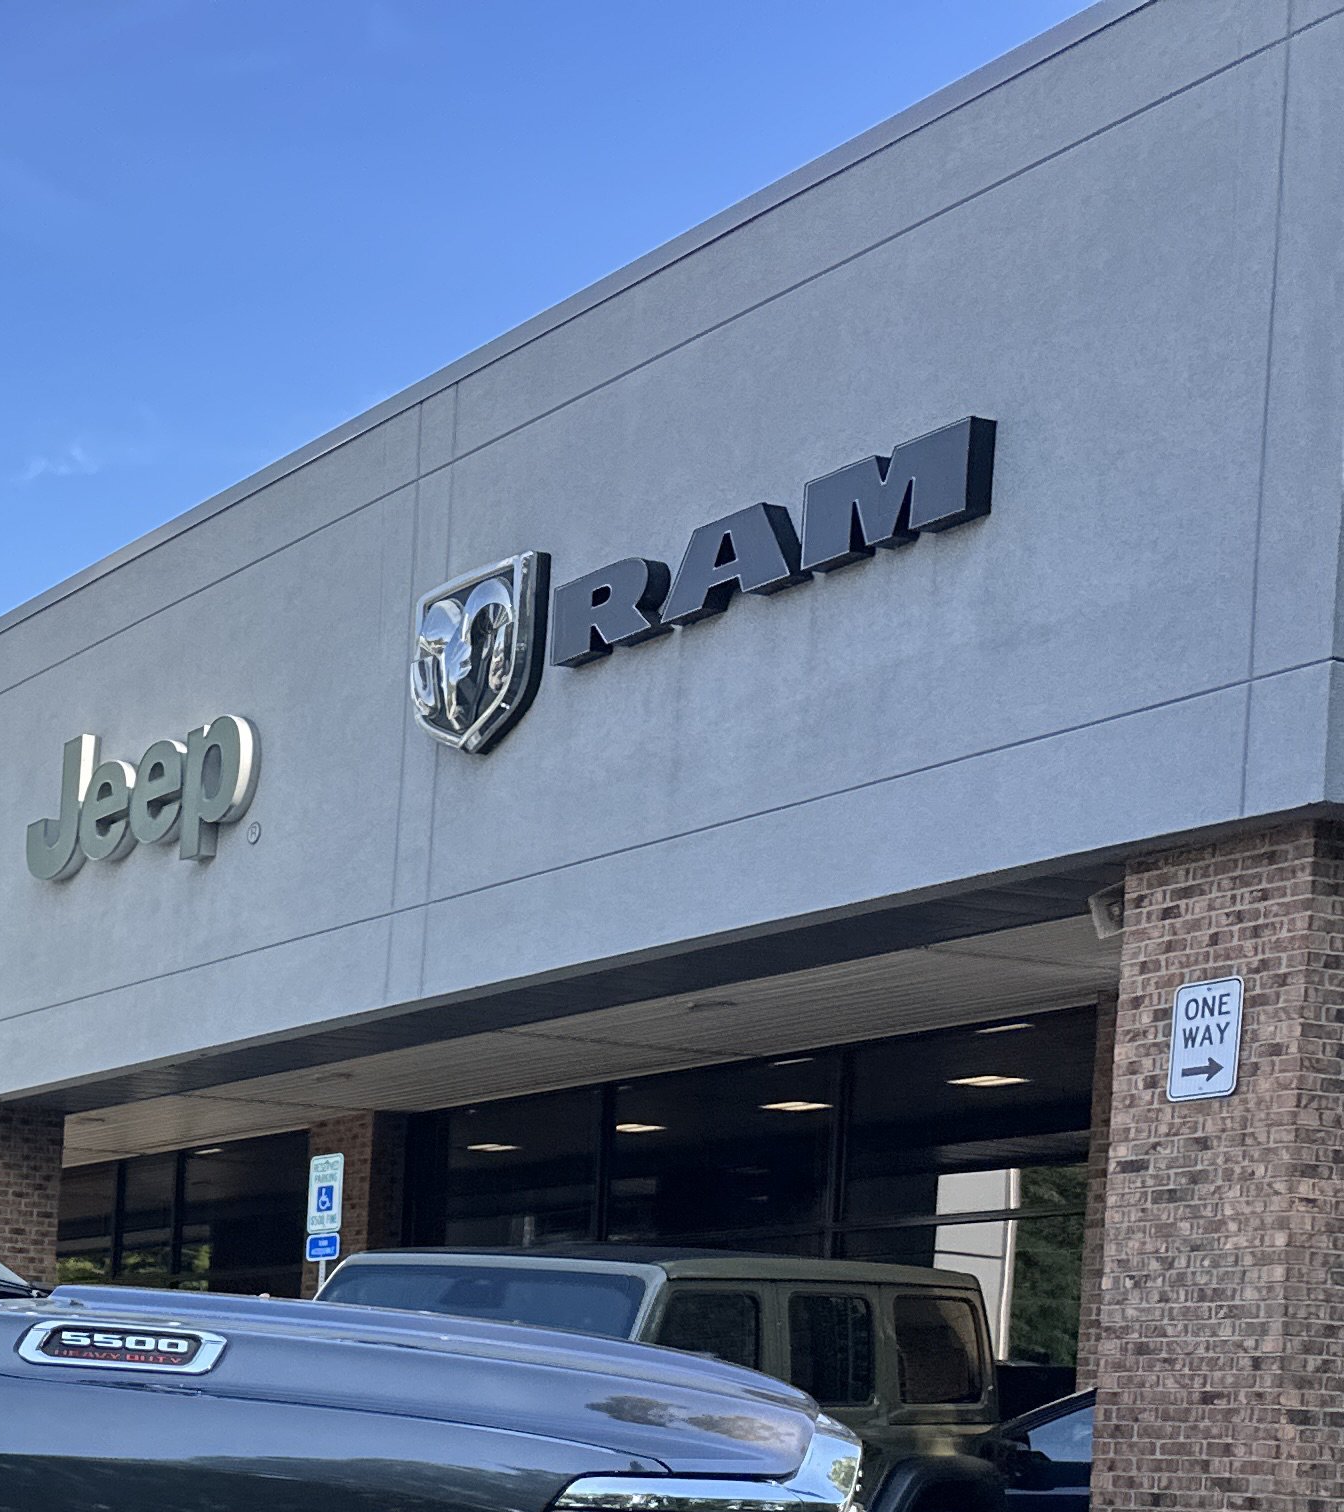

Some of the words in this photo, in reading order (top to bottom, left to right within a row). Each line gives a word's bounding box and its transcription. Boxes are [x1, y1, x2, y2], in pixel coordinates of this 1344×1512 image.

[549, 415, 996, 667] RAM
[26, 714, 260, 880] Jeep
[1185, 993, 1231, 1020] ONE
[1182, 1022, 1230, 1049] WAY
[61, 1331, 189, 1353] 5500
[54, 1349, 121, 1360] HEAVY
[125, 1353, 183, 1364] DUTY
